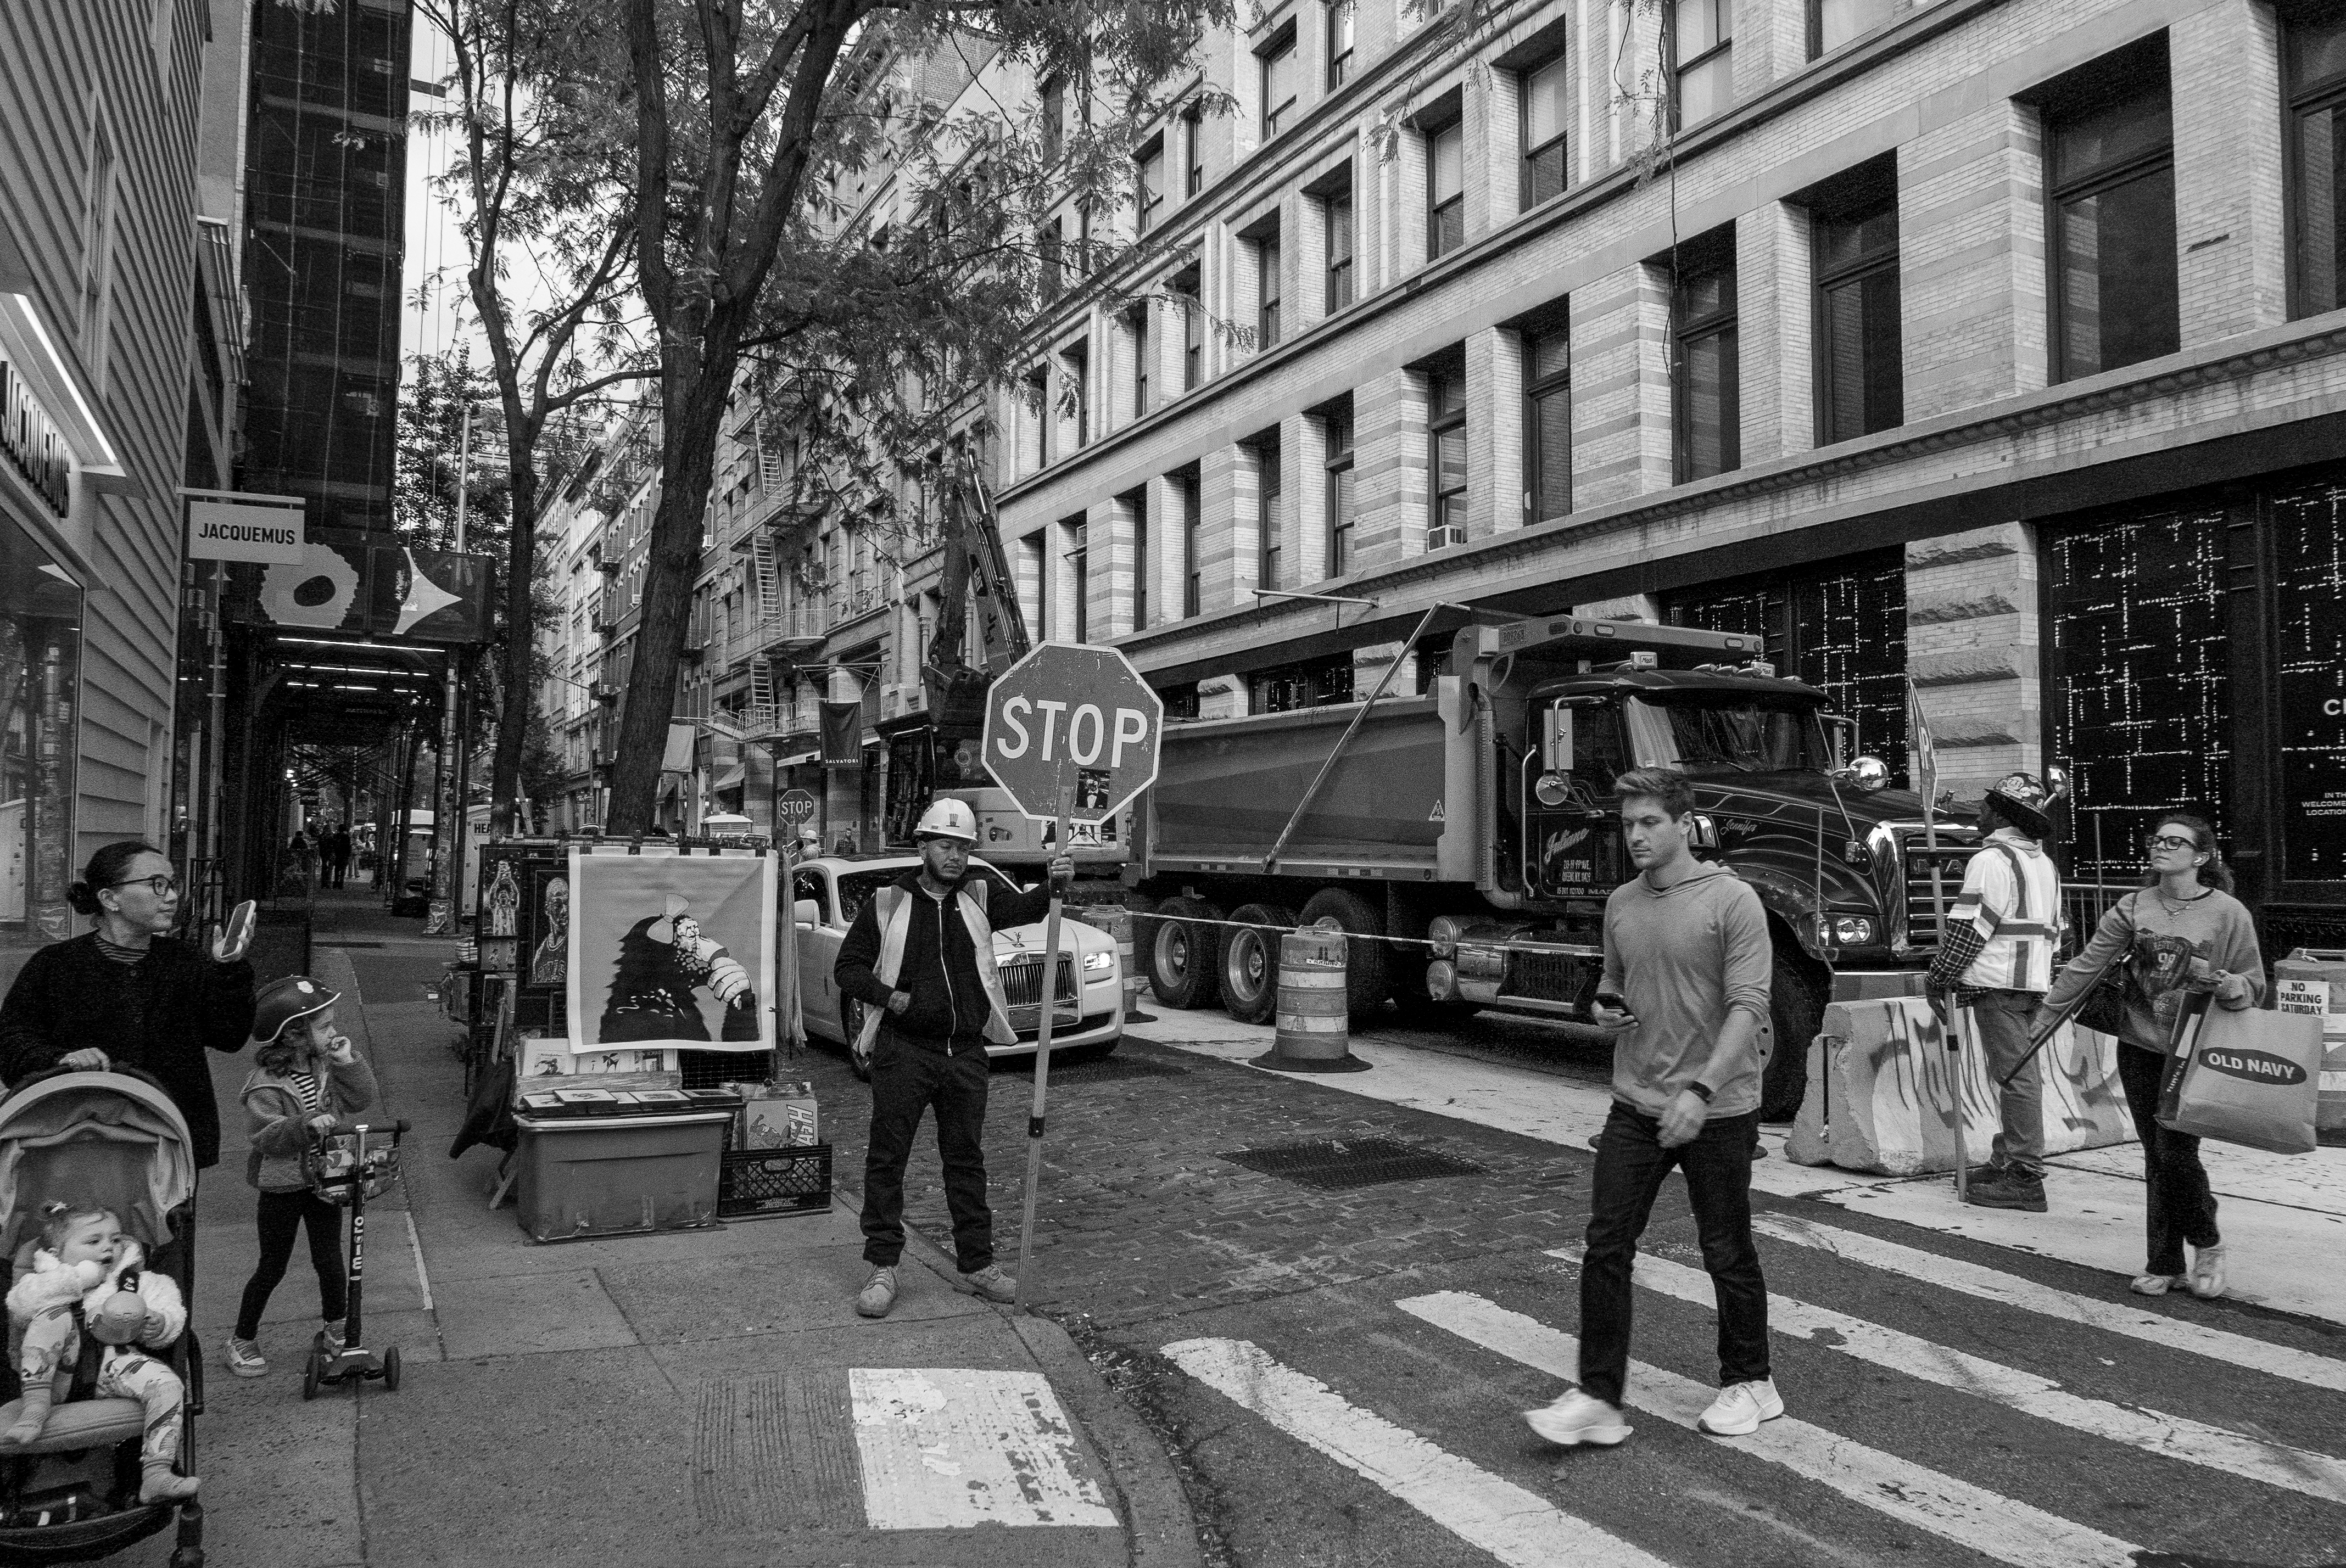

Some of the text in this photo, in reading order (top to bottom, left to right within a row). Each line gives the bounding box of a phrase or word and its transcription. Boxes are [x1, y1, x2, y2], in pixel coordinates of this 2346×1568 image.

[198, 523, 295, 545] JACQUEMUS
[997, 696, 1148, 768] STOP
[781, 800, 813, 815] STOP
[2291, 982, 2306, 992] NO
[2280, 992, 2322, 1004] PARKING
[2281, 1003, 2323, 1015] SATURDAY
[2208, 1052, 2295, 1079] OLD NAVY
[353, 1216, 364, 1270] micro
